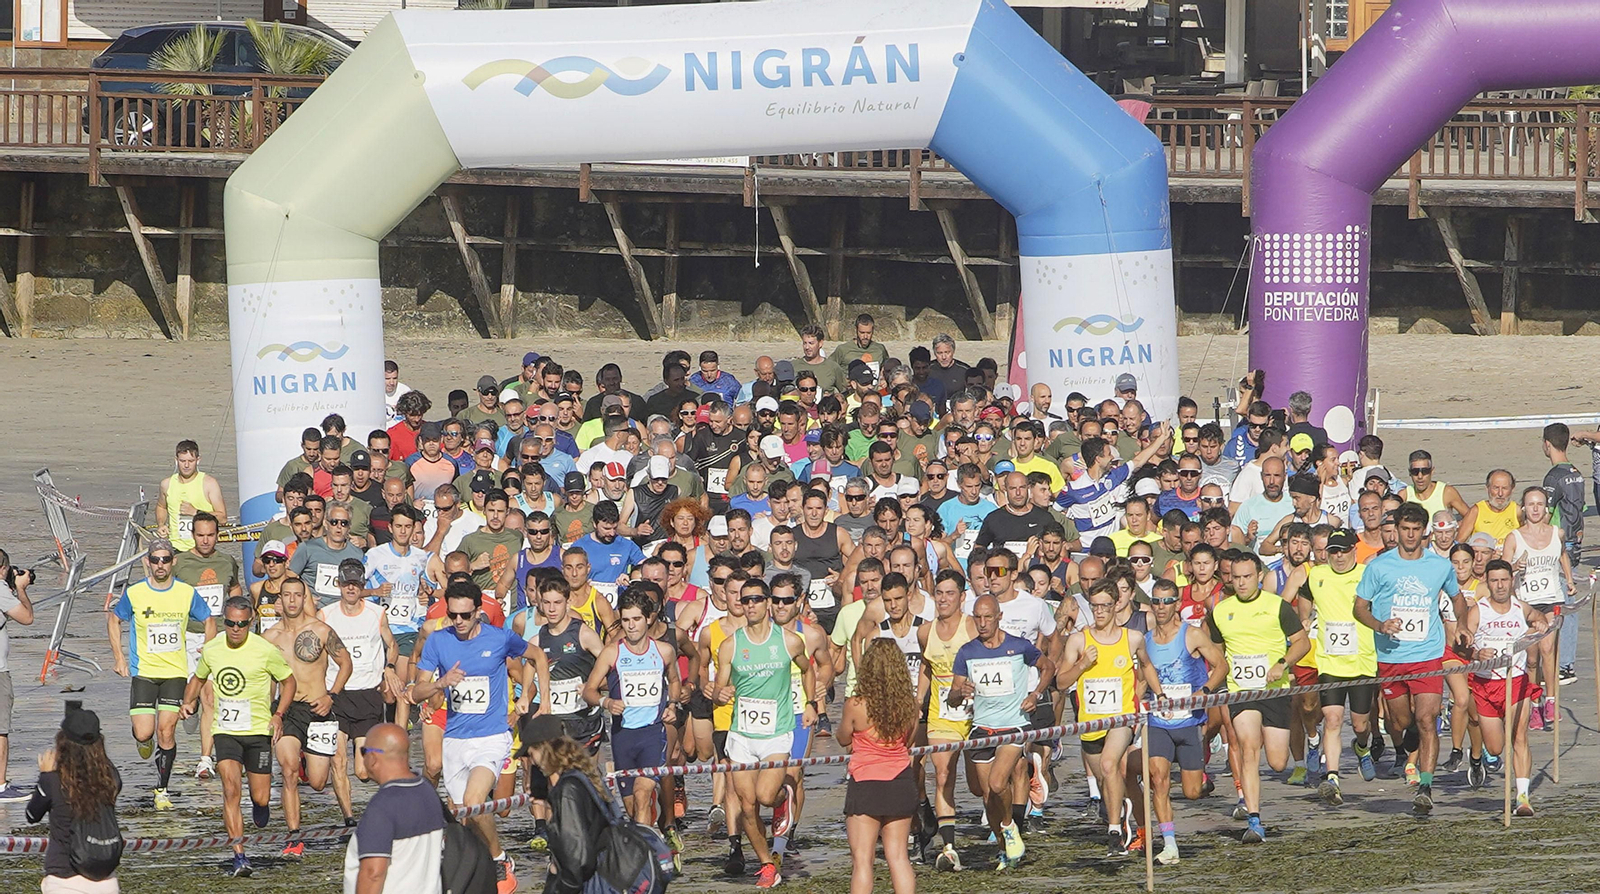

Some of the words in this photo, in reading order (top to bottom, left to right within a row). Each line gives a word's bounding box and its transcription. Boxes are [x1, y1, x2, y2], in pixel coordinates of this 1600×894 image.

[684, 36, 920, 91] NIGRÁN
[765, 103, 845, 119] Equilibrio
[852, 97, 919, 113] Natural
[1264, 288, 1359, 306] DEPUTACIÓN
[1264, 307, 1359, 321] PONTEVEDRA
[1049, 340, 1152, 368] NIGRÁN
[254, 368, 356, 395] NIGRÁN
[1063, 376, 1106, 387] Equilibrio
[266, 403, 309, 414] Equilibrio
[312, 401, 348, 412] Natural
[1328, 500, 1348, 515] 218
[1521, 577, 1549, 593] 189
[149, 632, 178, 645] 188
[1329, 633, 1350, 646] 93
[754, 662, 784, 670] MIGUEL
[1234, 665, 1266, 680] 250
[979, 672, 1003, 686] 44
[452, 689, 486, 704] 242
[625, 682, 659, 698] 256
[1088, 690, 1116, 704] 271
[222, 708, 240, 721] 27
[741, 710, 770, 725] 195
